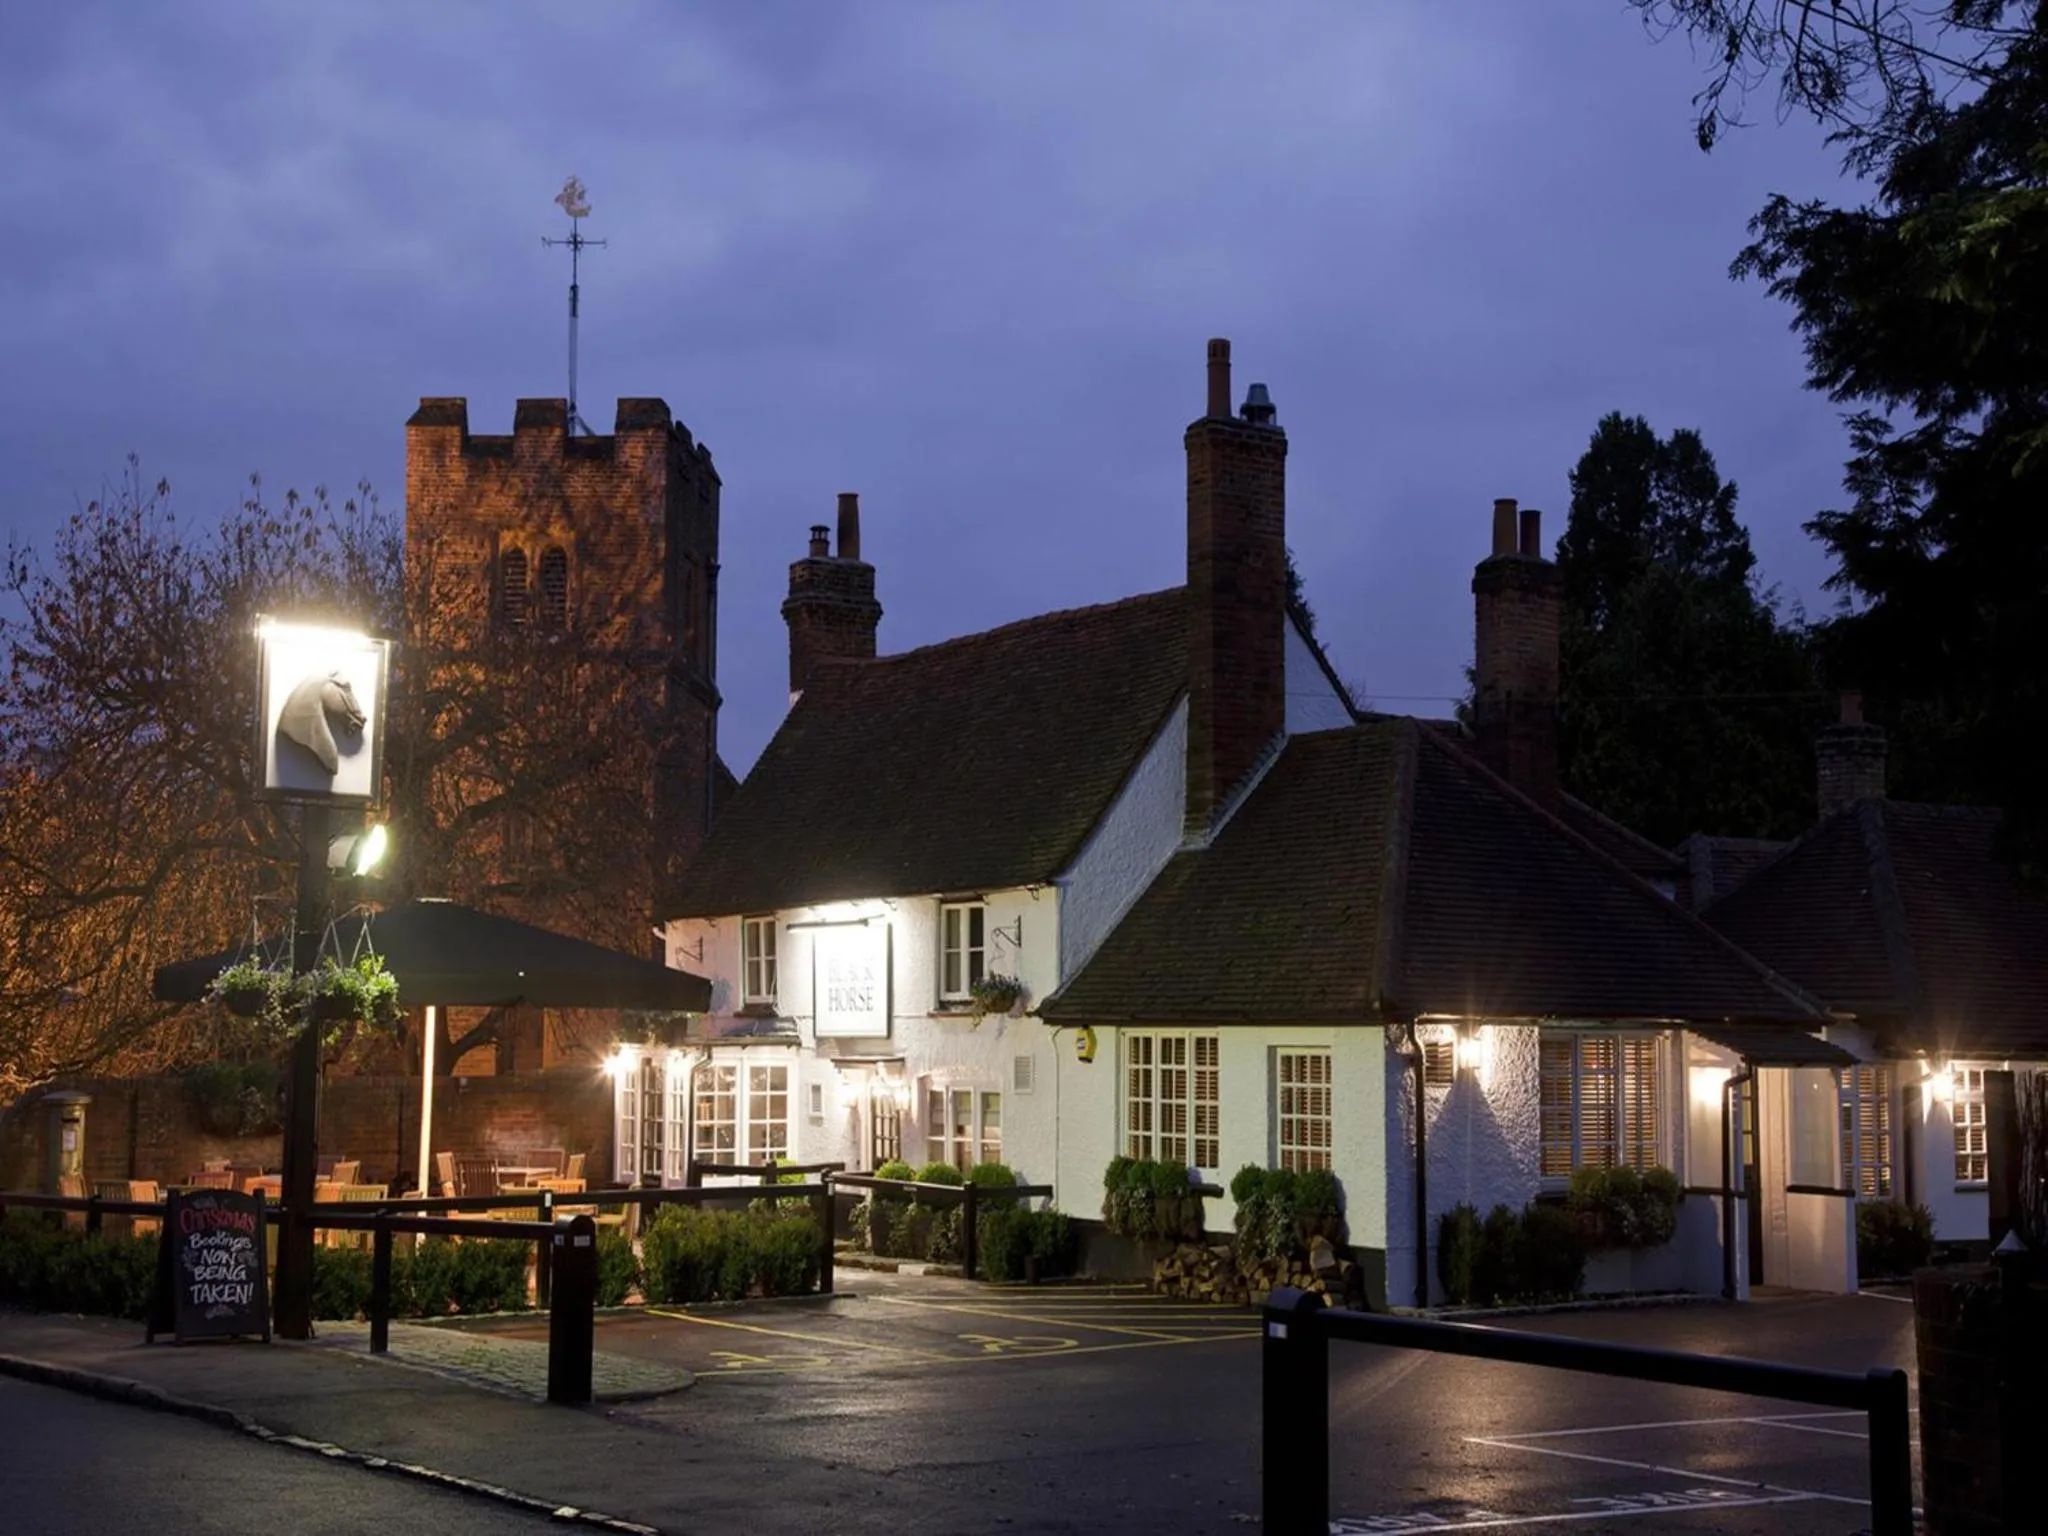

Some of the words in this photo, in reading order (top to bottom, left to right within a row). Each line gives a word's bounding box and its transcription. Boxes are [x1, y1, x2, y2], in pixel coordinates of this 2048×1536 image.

[828, 957, 874, 982] BLAK
[828, 986, 874, 1012] HORSE
[193, 1264, 246, 1281] BEING
[190, 1282, 254, 1304] TAKEN!
